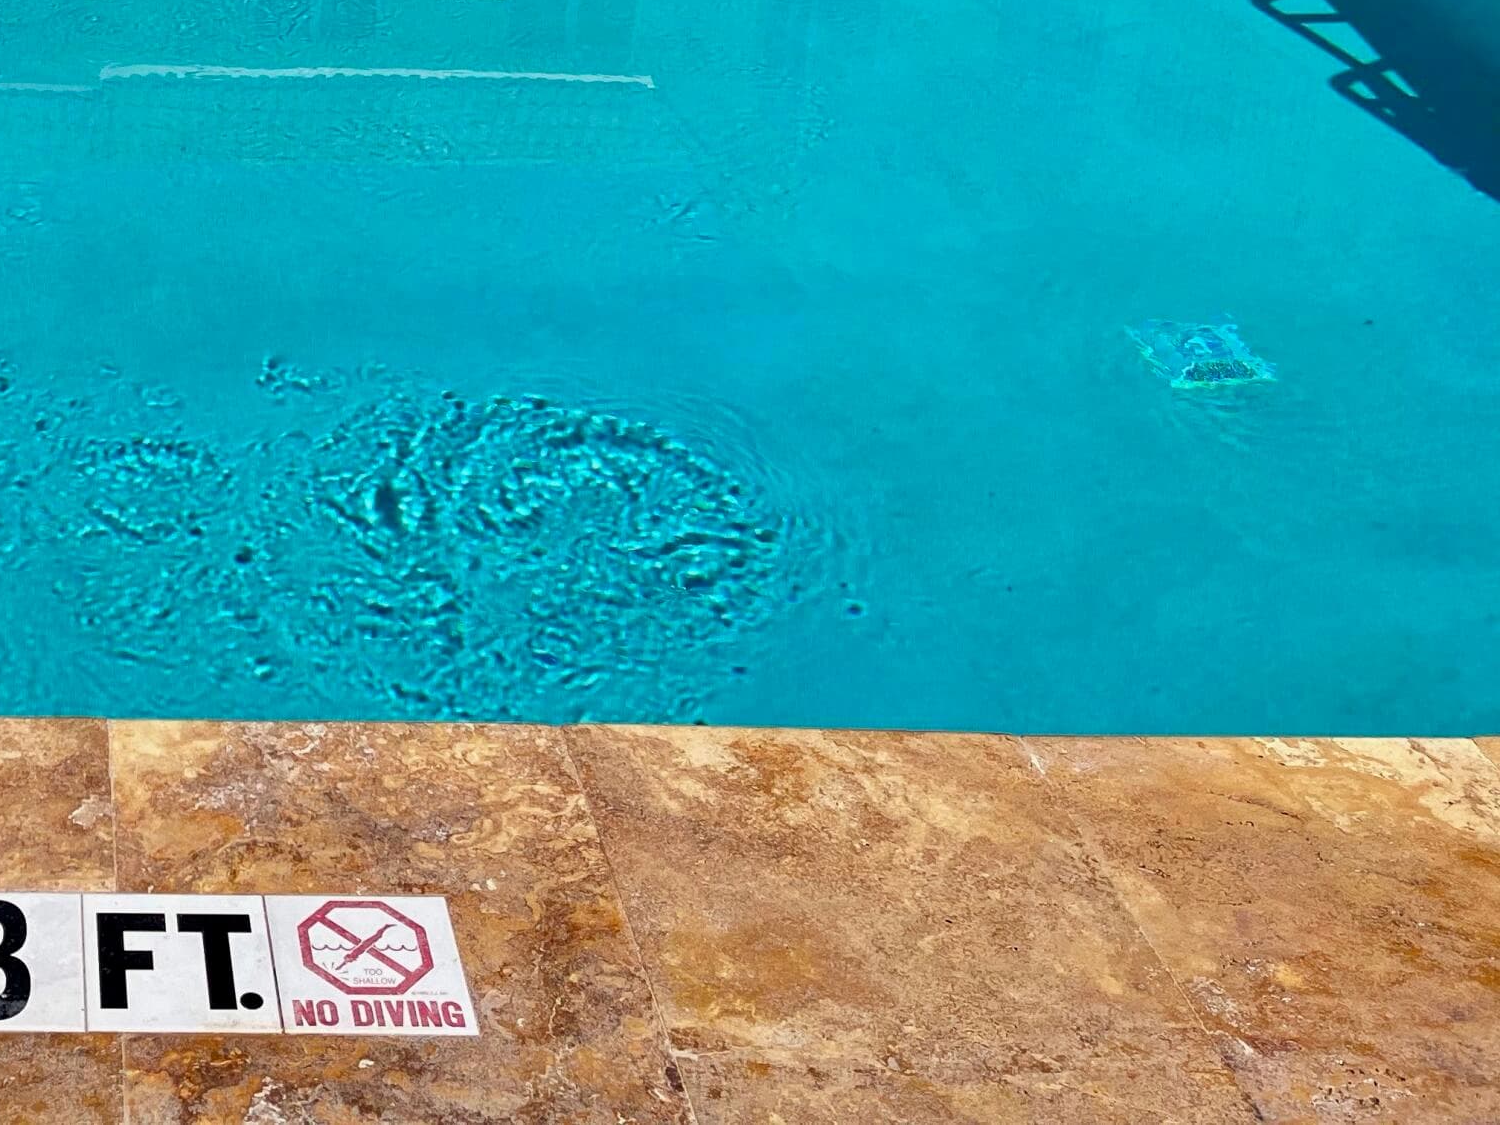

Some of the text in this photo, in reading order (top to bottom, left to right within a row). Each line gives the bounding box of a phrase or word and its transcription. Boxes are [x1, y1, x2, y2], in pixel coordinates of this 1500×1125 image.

[96, 912, 264, 1011] FT.
[352, 977, 396, 985] SHALLOW
[364, 968, 383, 976] TOO
[292, 999, 466, 1028] NO DIVING
